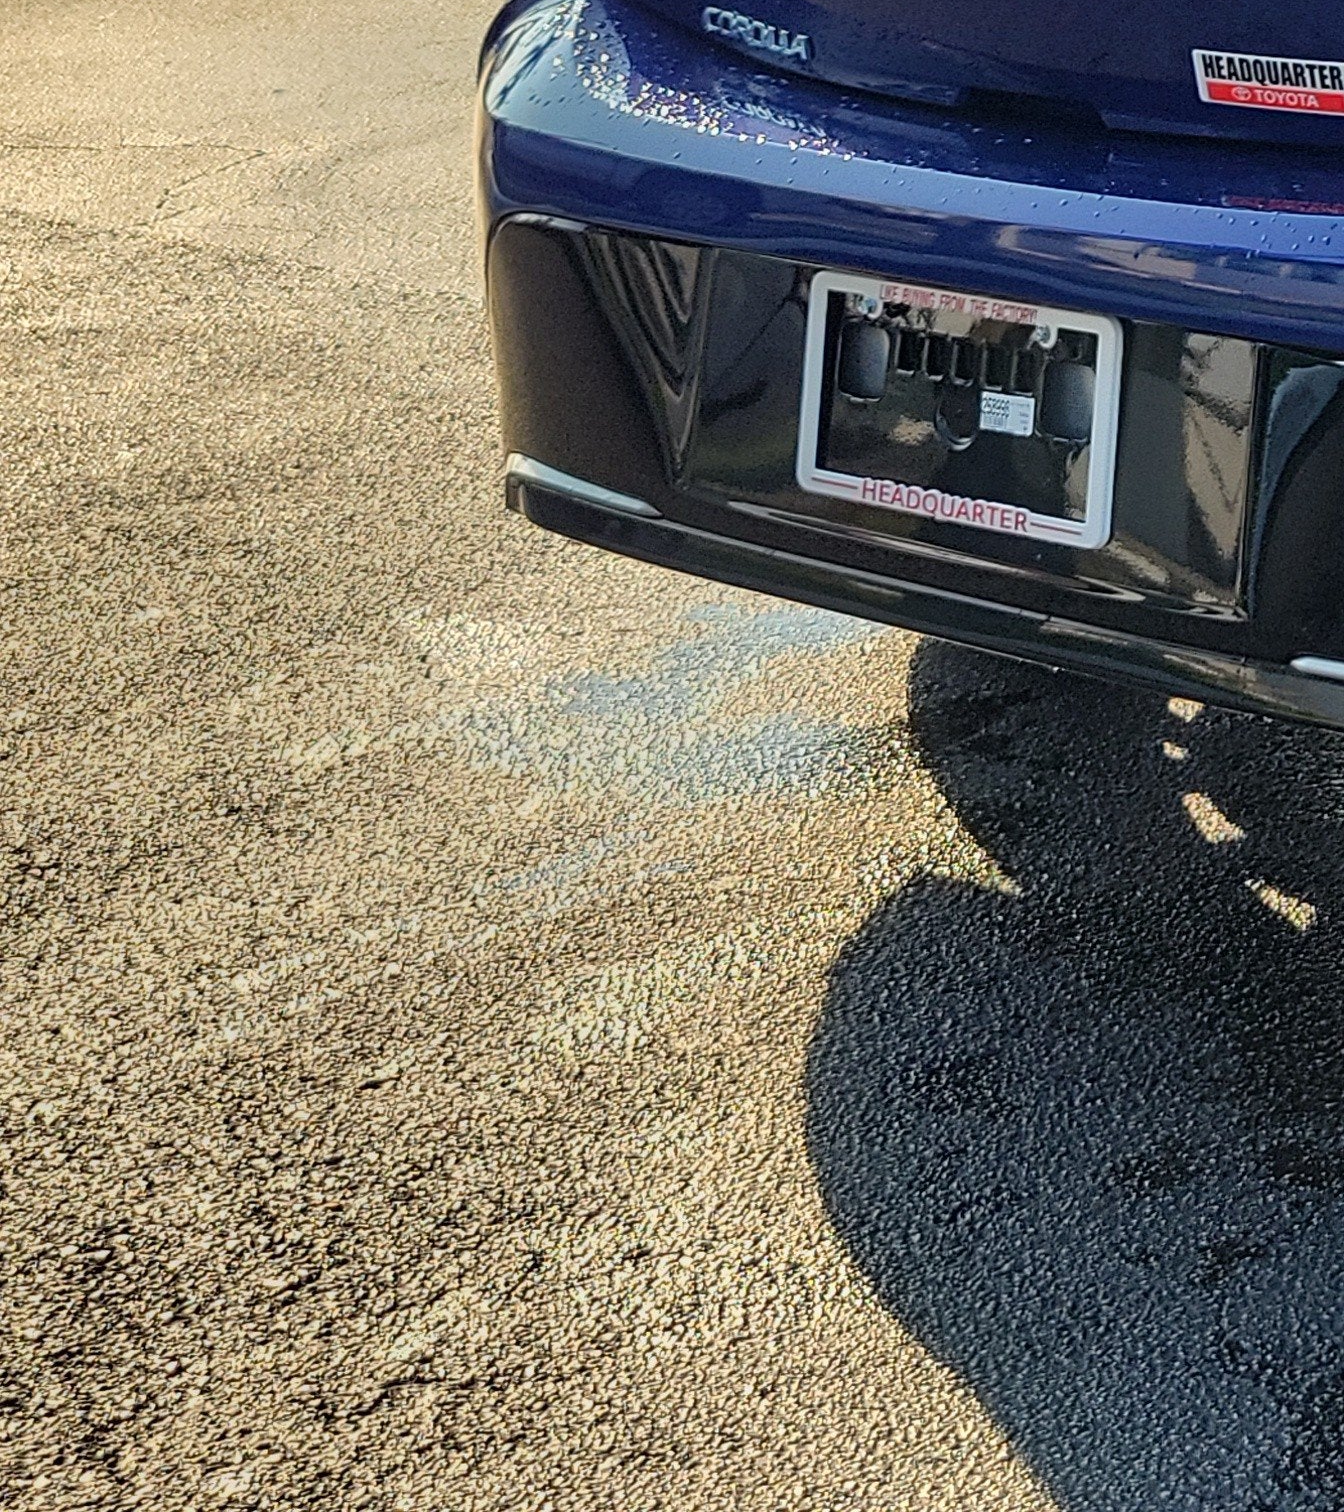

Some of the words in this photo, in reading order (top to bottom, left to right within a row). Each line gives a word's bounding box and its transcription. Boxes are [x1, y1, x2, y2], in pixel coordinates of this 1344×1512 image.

[702, 6, 809, 61] COROLLA
[1201, 53, 1344, 90] HEADQUARTER
[1254, 88, 1320, 109] TOYOTA
[861, 479, 1028, 532] HEADQUARTER
